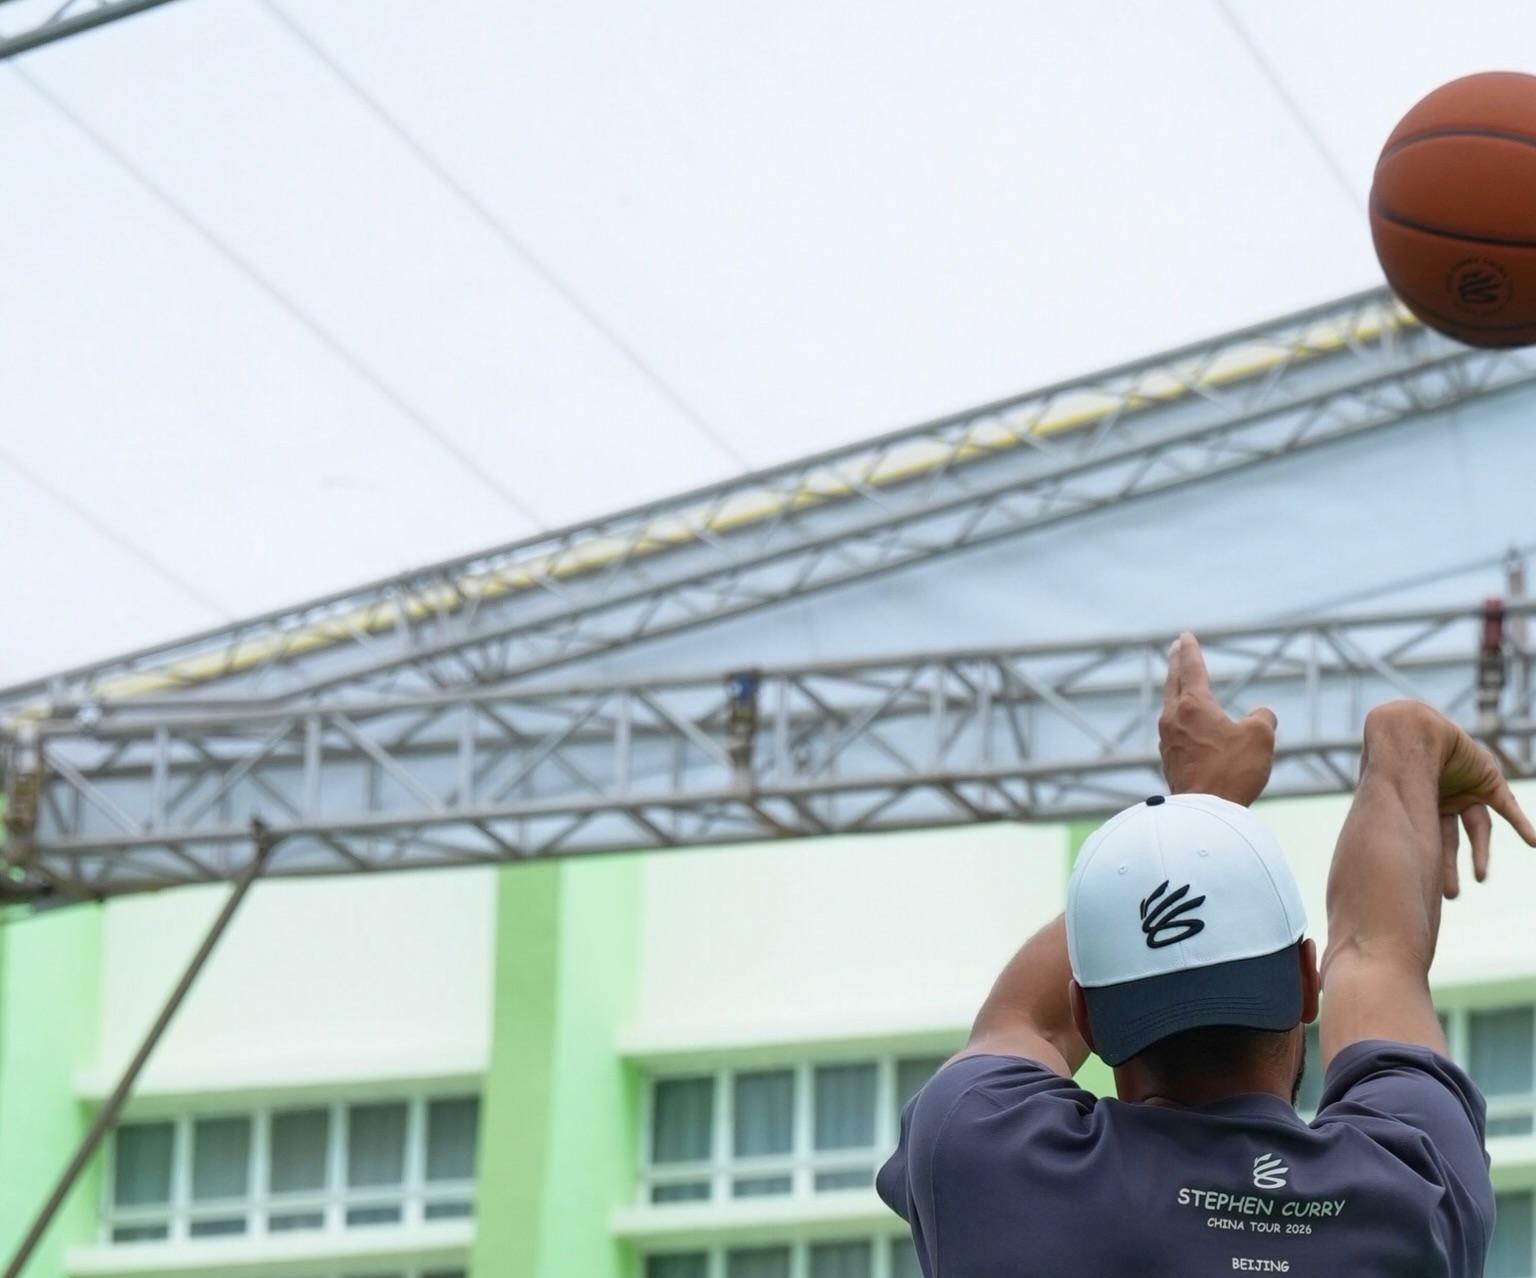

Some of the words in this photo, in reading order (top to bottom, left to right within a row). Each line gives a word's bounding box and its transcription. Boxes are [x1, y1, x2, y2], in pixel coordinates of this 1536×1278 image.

[1177, 1188, 1274, 1217] STEPHEN
[1282, 1200, 1346, 1218] CURRY
[1207, 1218, 1245, 1231] CHINA
[1249, 1221, 1281, 1234] TOUR
[1285, 1223, 1312, 1235] 2026
[1232, 1257, 1290, 1273] BEIJING
